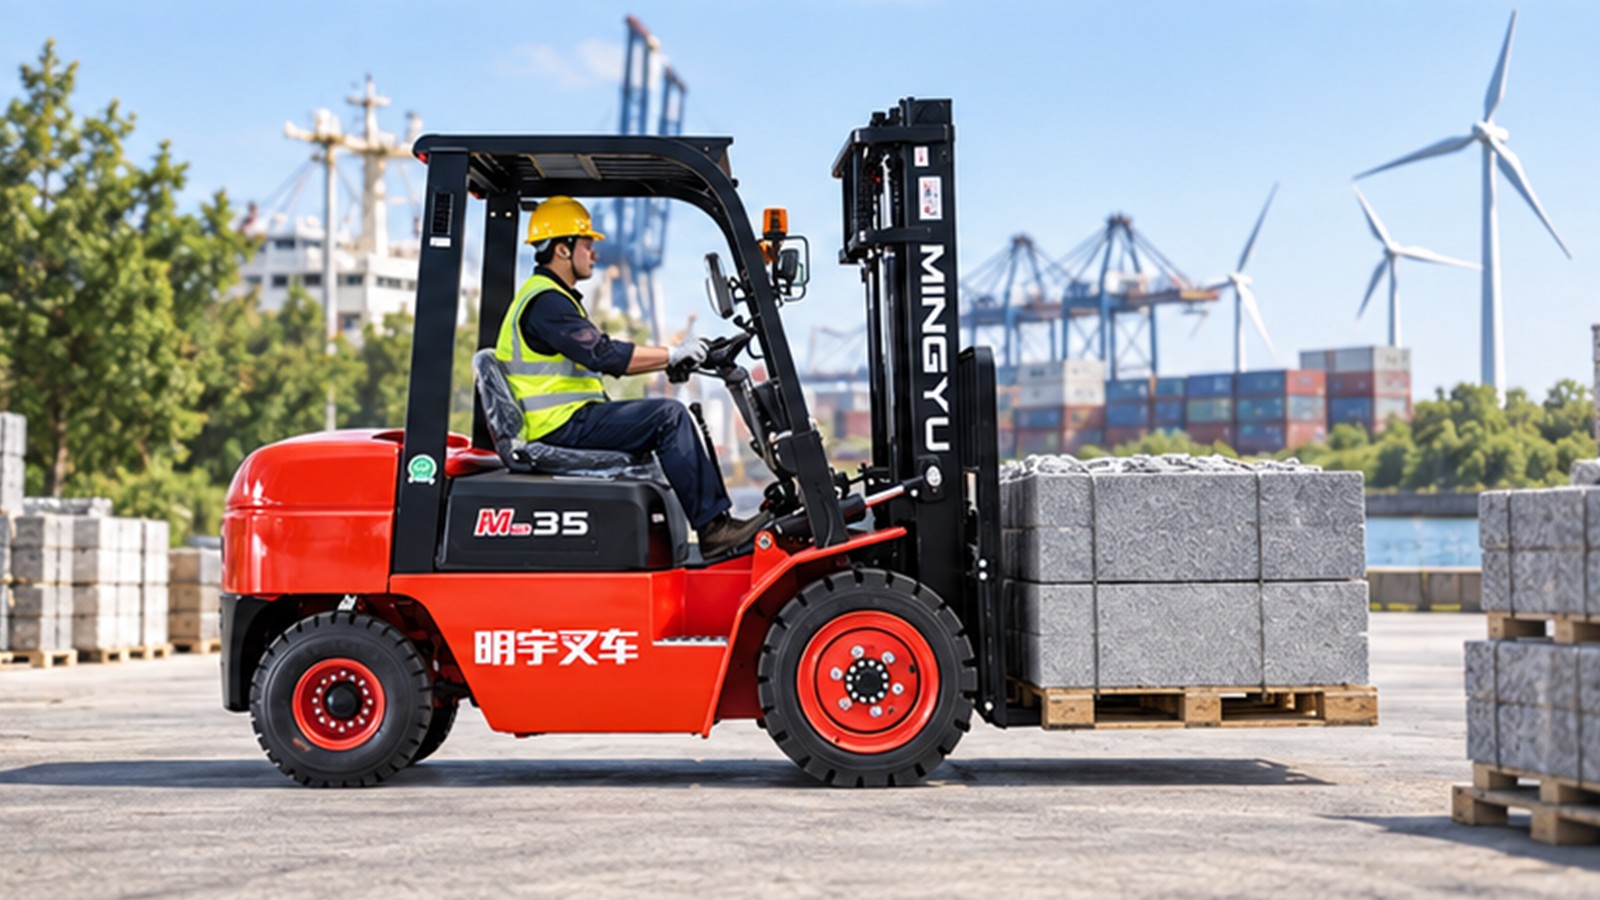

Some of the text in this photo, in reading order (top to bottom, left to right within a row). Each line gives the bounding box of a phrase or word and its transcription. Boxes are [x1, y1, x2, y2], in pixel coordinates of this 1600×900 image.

[920, 244, 950, 451] MINGYU
[474, 628, 639, 666] 明宇叉车
